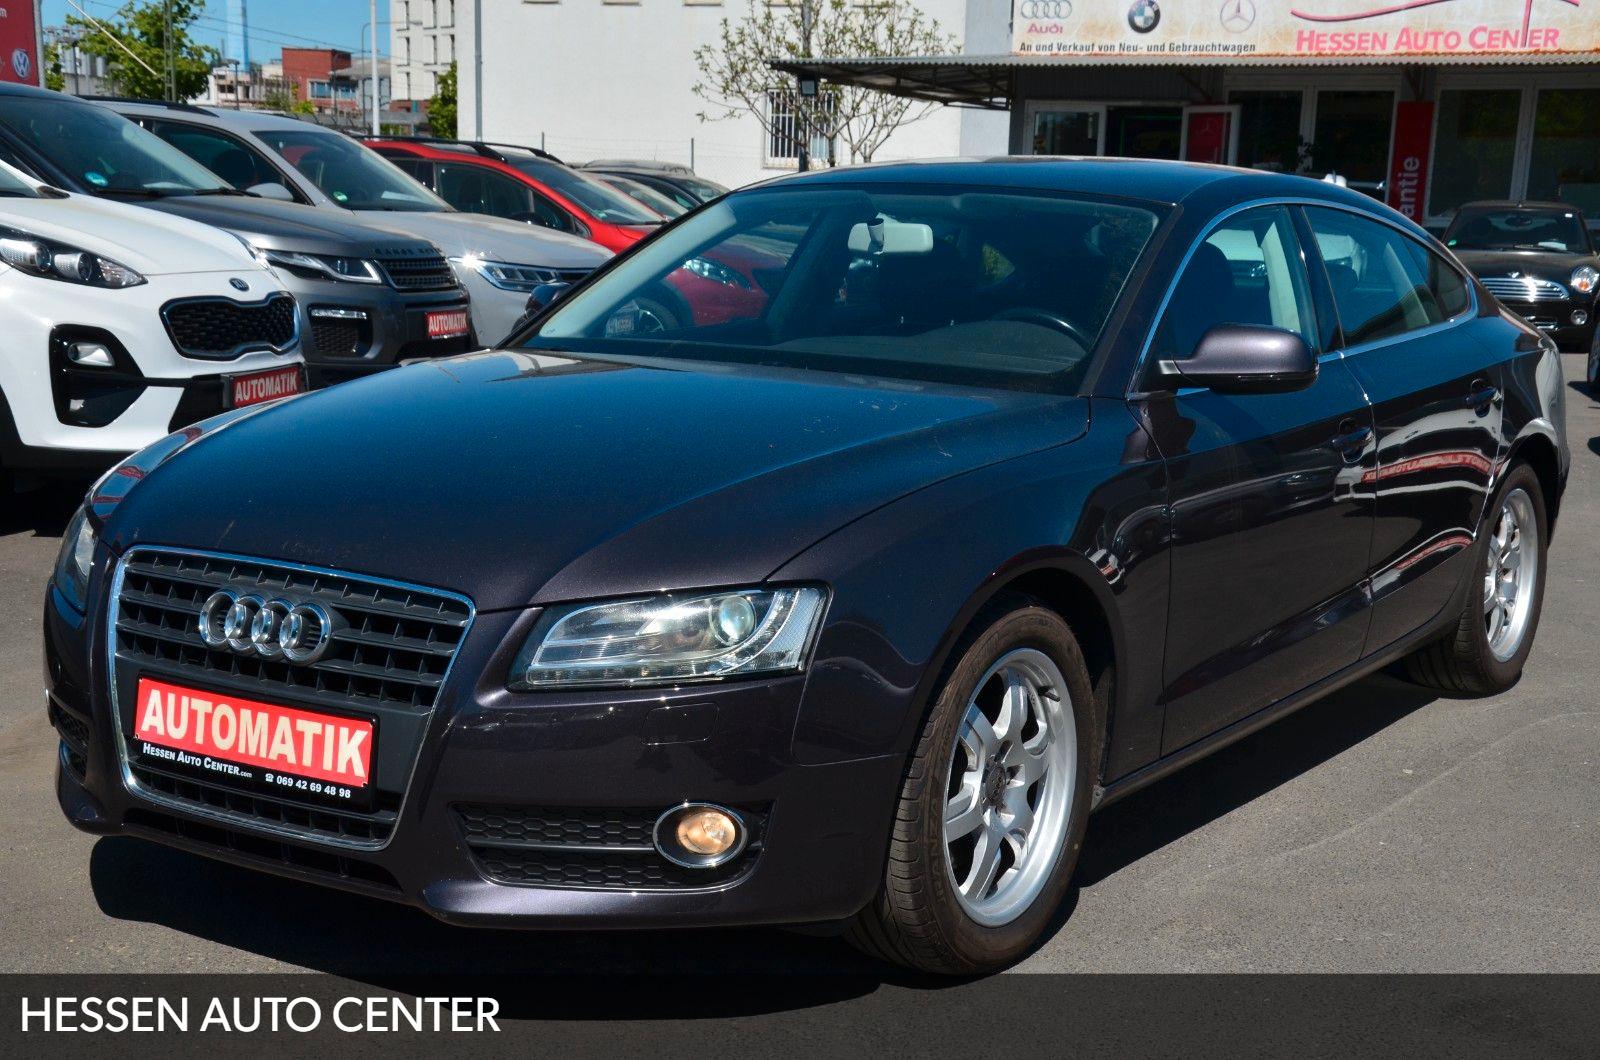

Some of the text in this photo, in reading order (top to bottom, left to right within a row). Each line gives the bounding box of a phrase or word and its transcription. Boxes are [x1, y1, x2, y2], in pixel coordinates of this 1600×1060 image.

[1020, 42, 1256, 56] An und Verkauf von Neu- und Gebrauchtwagen
[1295, 25, 1560, 51] HESSEN AUTO CENTER
[428, 316, 467, 333] AUTOMATIK
[234, 372, 297, 402] AUTOMATIK
[141, 688, 368, 778] AUTOMATIK
[143, 742, 175, 760] HESSEN
[177, 751, 201, 767] AUTO
[276, 775, 351, 799] 069 42 69 48 98
